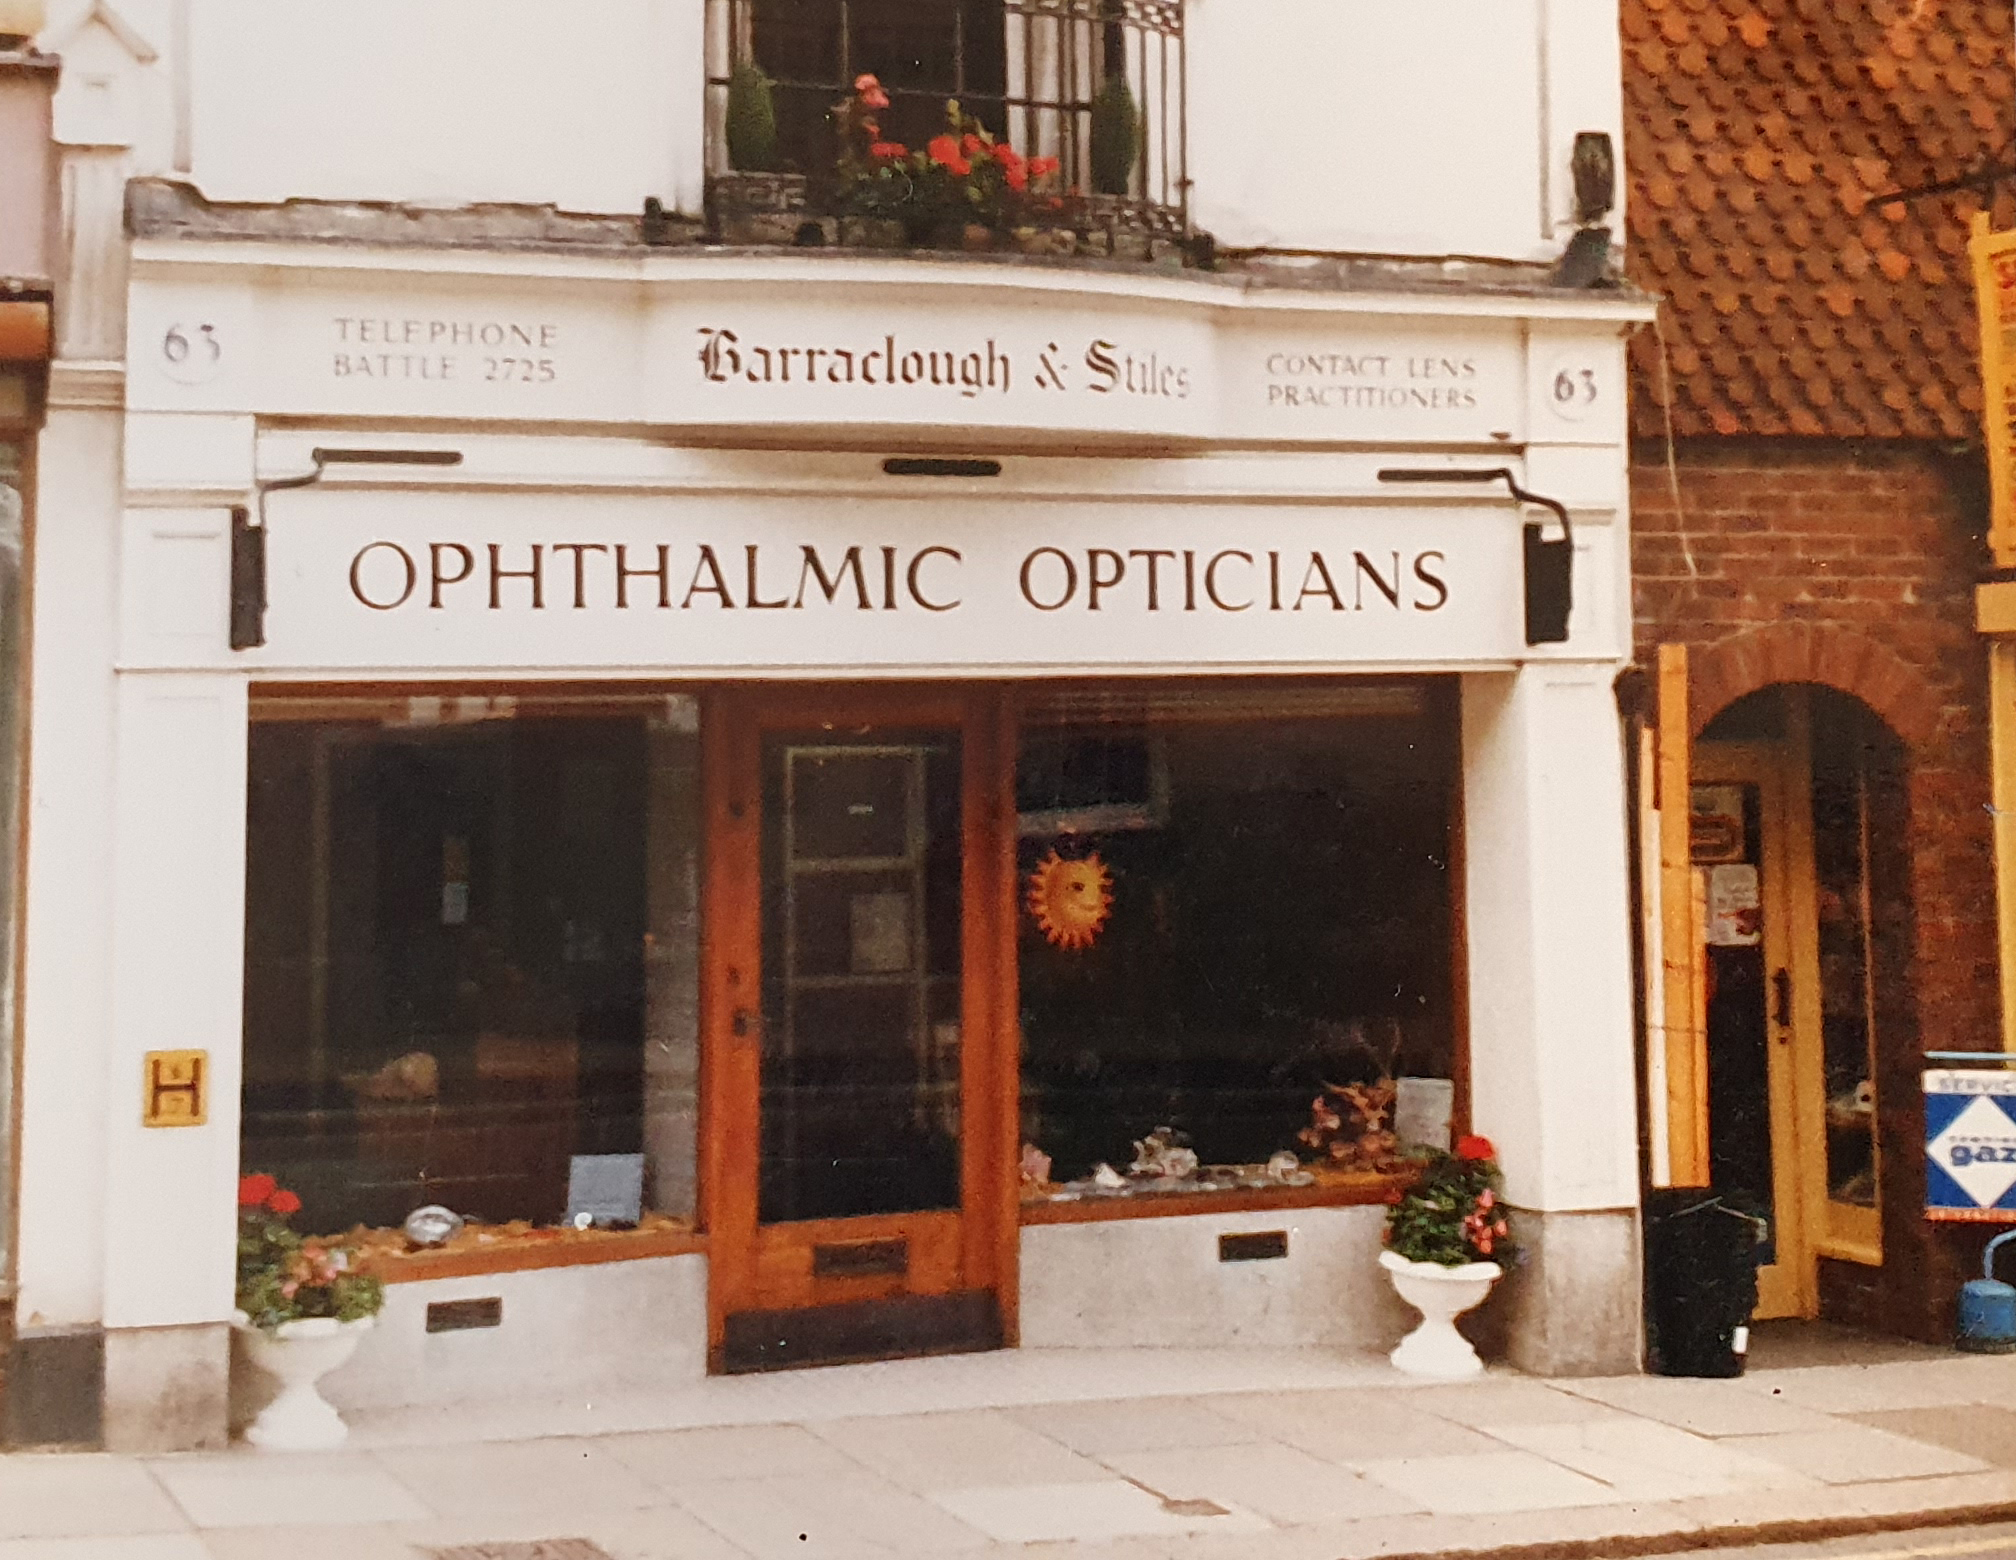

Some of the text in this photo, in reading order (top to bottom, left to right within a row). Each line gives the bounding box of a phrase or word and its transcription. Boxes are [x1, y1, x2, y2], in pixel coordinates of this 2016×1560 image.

[164, 323, 221, 362] 63
[334, 318, 557, 347] TELEPHONE
[334, 354, 556, 382] BATTLE 2725
[697, 327, 1190, 398] Barraclough & Stiles
[1267, 354, 1476, 378] CONTACT LENS
[1268, 385, 1477, 409] PRACTITIONERS
[1553, 369, 1597, 403] 63
[349, 541, 1449, 613] OPHTHALMIC OPTICIANS
[151, 1058, 200, 1117] H
